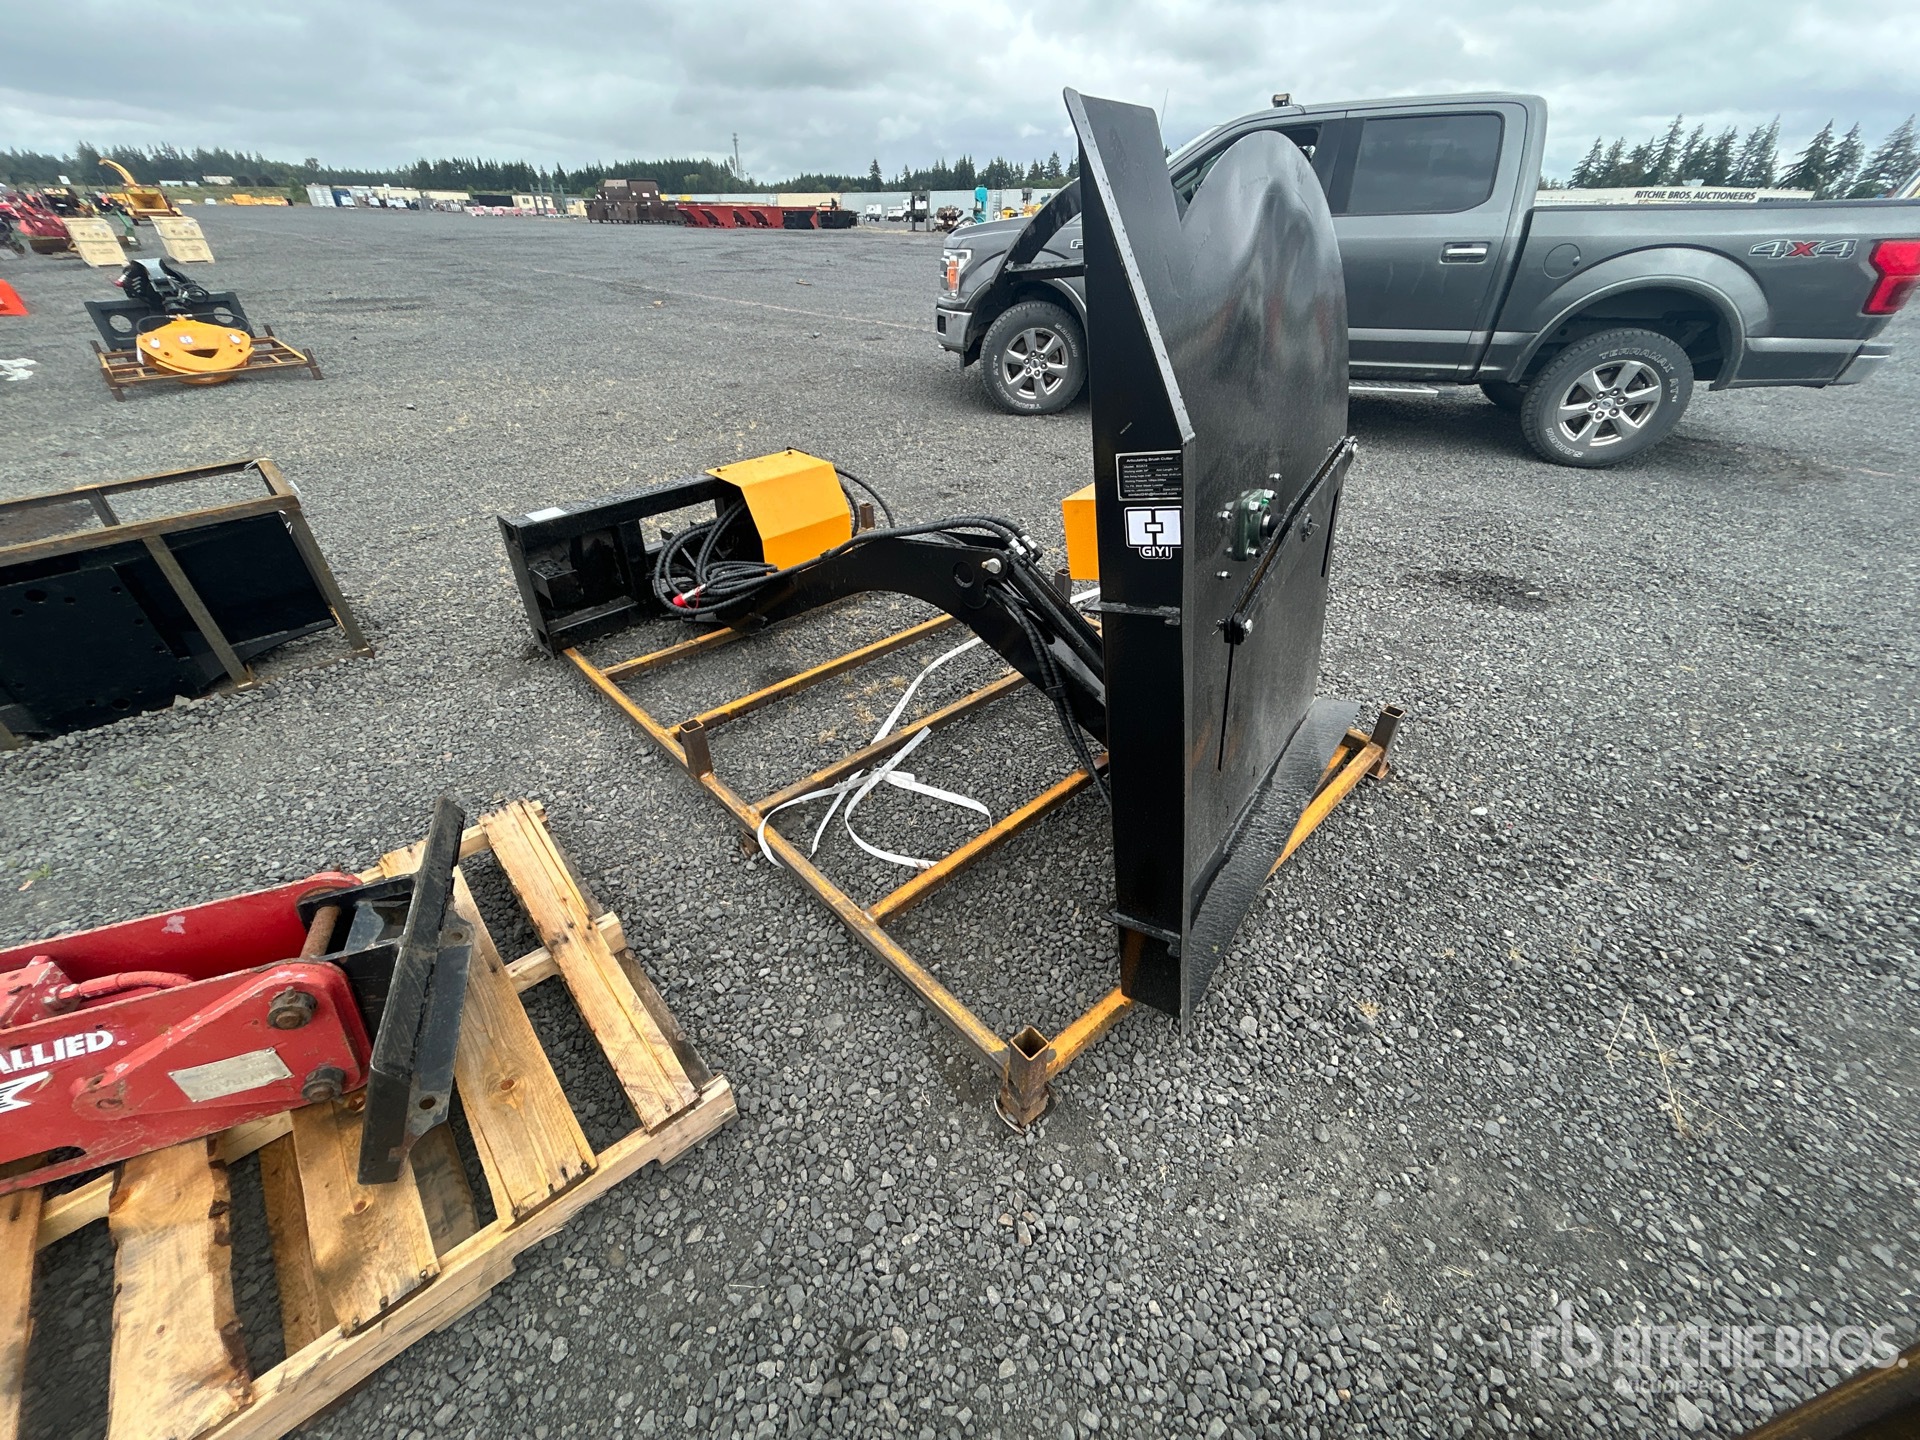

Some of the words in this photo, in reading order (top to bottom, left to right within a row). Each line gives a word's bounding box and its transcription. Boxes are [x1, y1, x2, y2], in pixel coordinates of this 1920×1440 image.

[1634, 190, 1667, 199] RITCHIE
[1667, 190, 1692, 200] BROS.
[1693, 191, 1757, 200] AUCTIONEERS
[1598, 347, 1675, 373] TERRAMAX
[1545, 427, 1584, 458] SAILUN
[1141, 546, 1169, 557] GIYI
